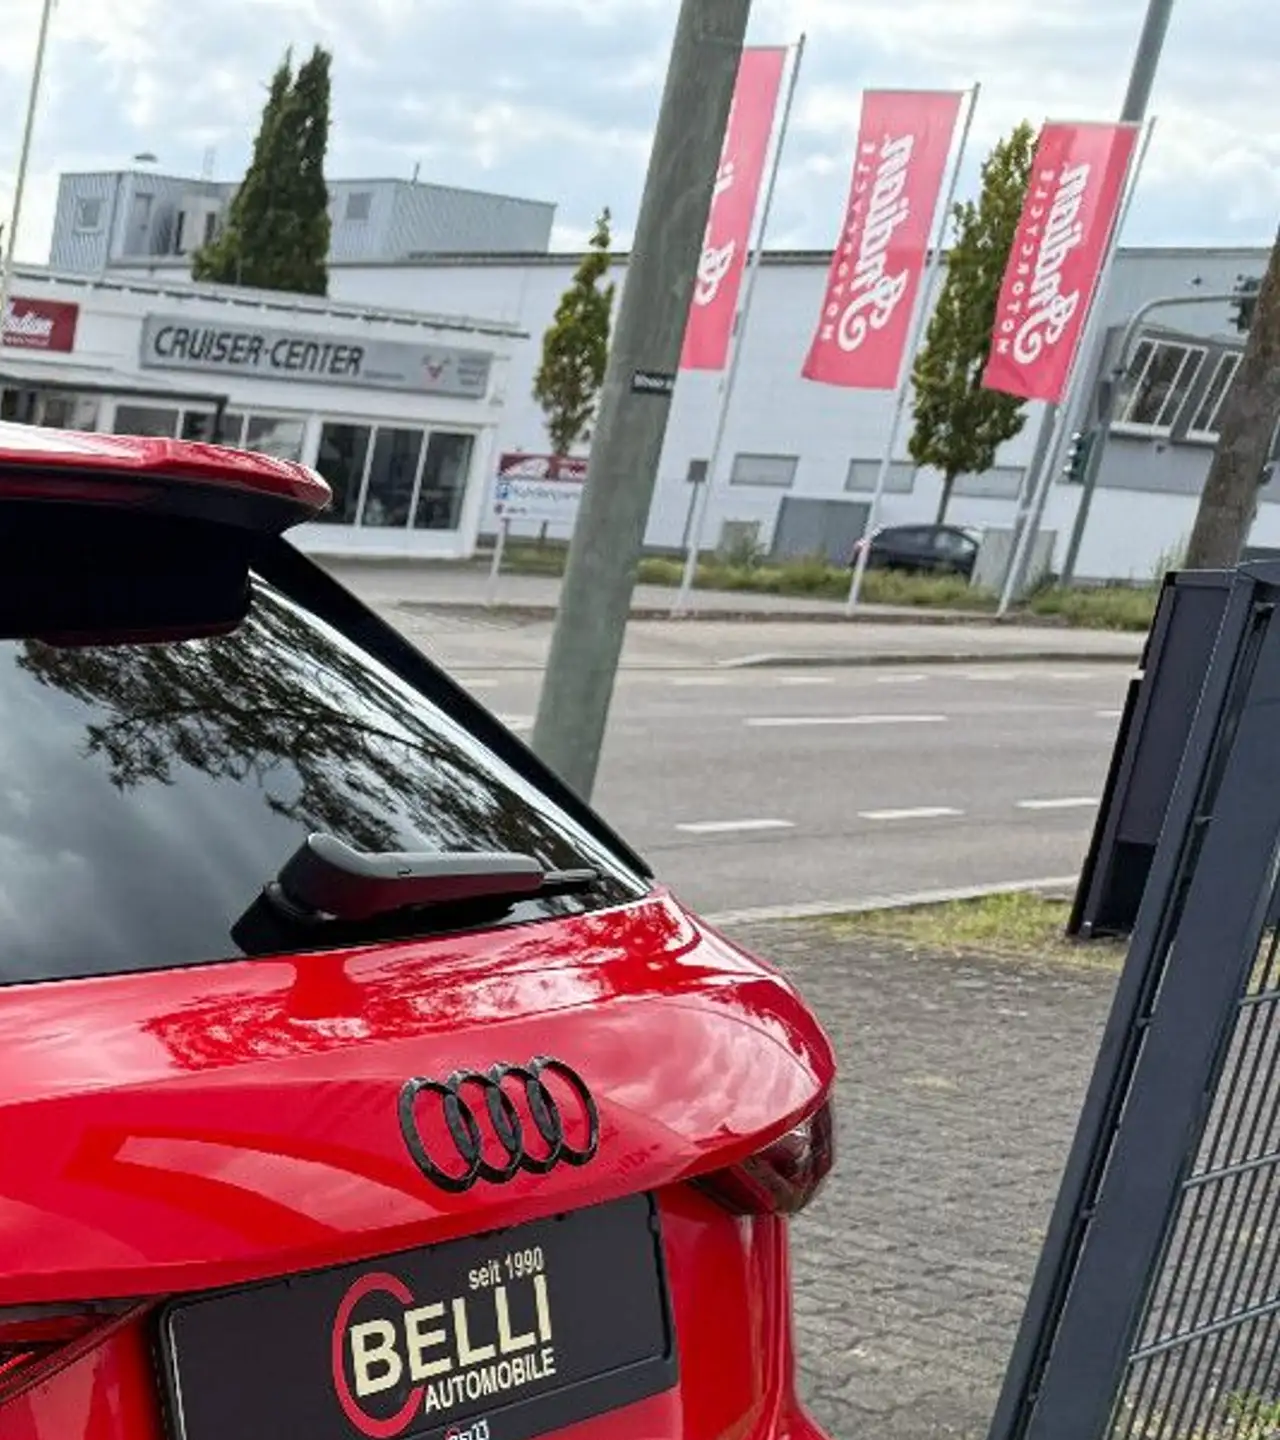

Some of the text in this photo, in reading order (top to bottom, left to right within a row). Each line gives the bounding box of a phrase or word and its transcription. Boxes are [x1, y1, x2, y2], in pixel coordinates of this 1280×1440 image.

[468, 1246, 545, 1290] seit 1990
[349, 1273, 552, 1398] BELLI
[424, 1347, 557, 1415] AUTOMOBILE
